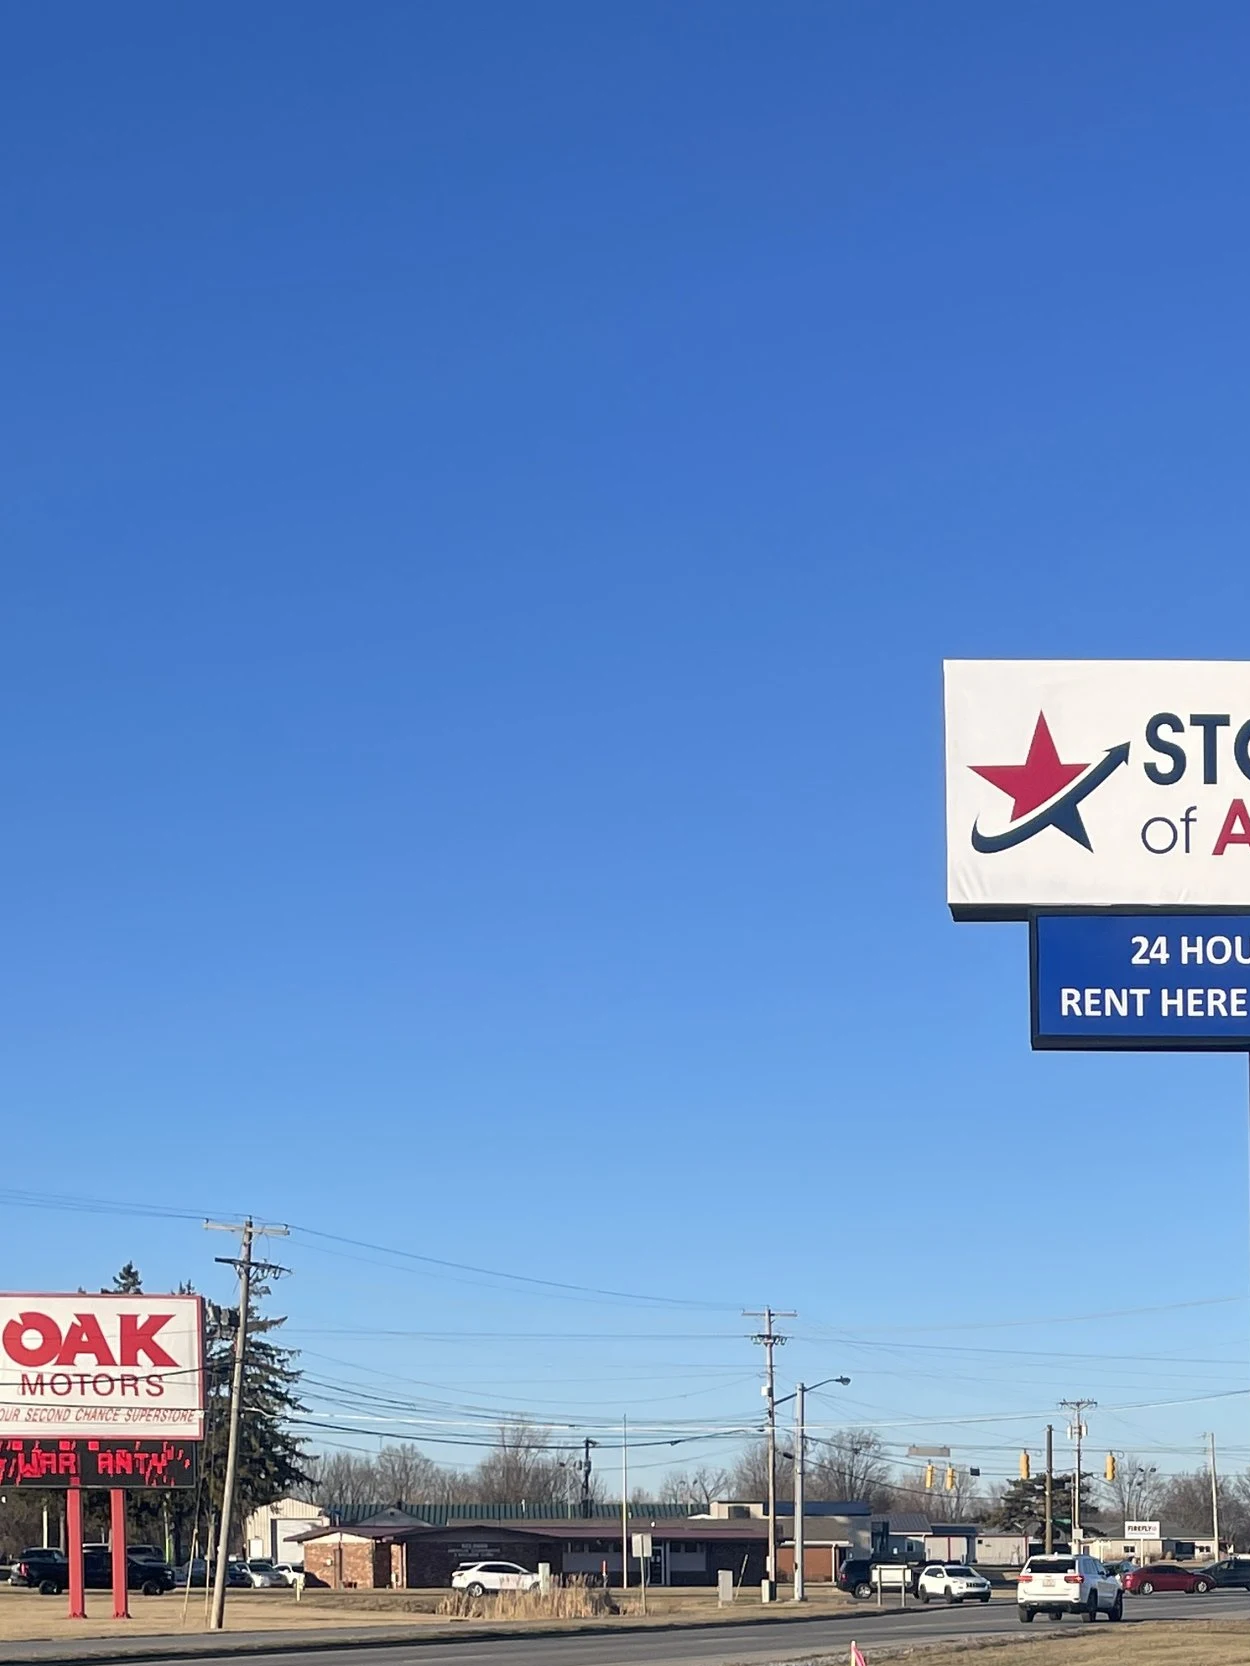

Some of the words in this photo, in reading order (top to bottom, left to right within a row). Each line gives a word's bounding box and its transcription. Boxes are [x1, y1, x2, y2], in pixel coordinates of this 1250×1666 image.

[1140, 805, 1198, 855] of
[1131, 935, 1170, 965] 24
[1061, 988, 1151, 1017] RENT
[1161, 988, 1248, 1017] HERE
[2, 1311, 182, 1368] OAK
[21, 1373, 165, 1397] MOTORS
[24, 1407, 71, 1422] SECOND
[74, 1407, 121, 1422] CHANCE
[124, 1408, 195, 1423] SUPERSTORE
